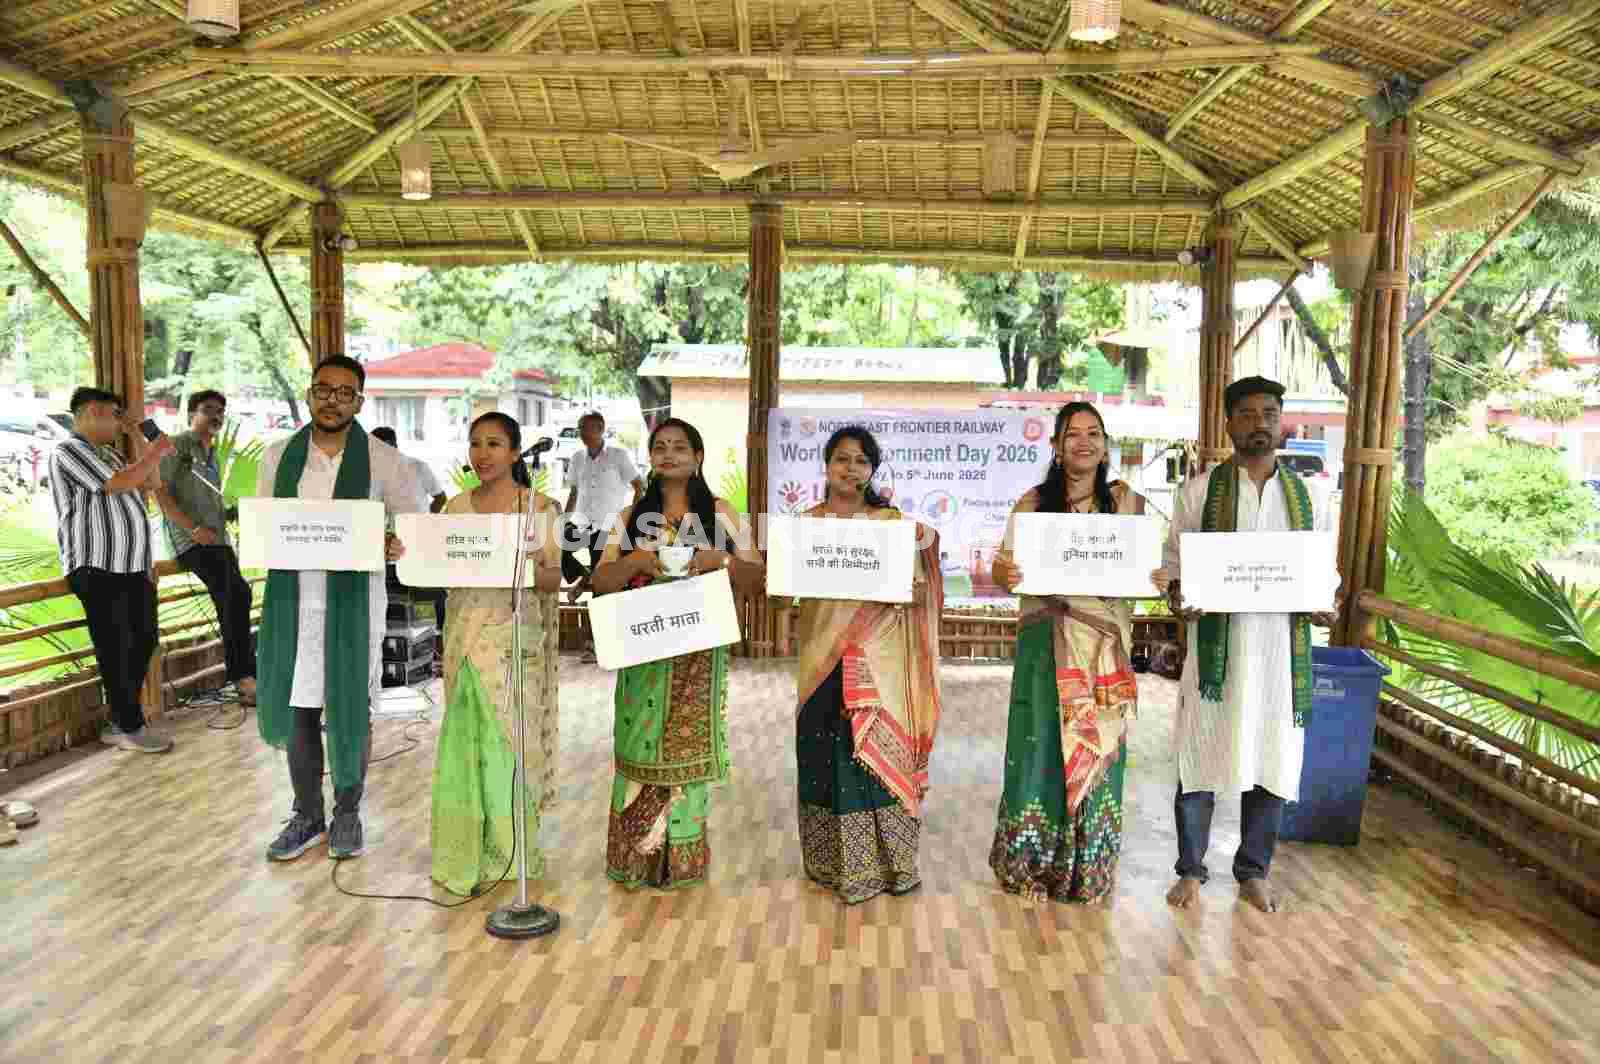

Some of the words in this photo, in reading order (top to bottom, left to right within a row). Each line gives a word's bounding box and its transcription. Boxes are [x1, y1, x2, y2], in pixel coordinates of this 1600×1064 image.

[892, 420, 951, 434] FRONTIER
[953, 421, 1006, 433] RAILWAY
[780, 443, 824, 462] Worl
[957, 443, 990, 467] Day
[997, 444, 1037, 463] 2026
[924, 470, 955, 481] June
[629, 613, 666, 637] धरती
[670, 609, 702, 629] माता
